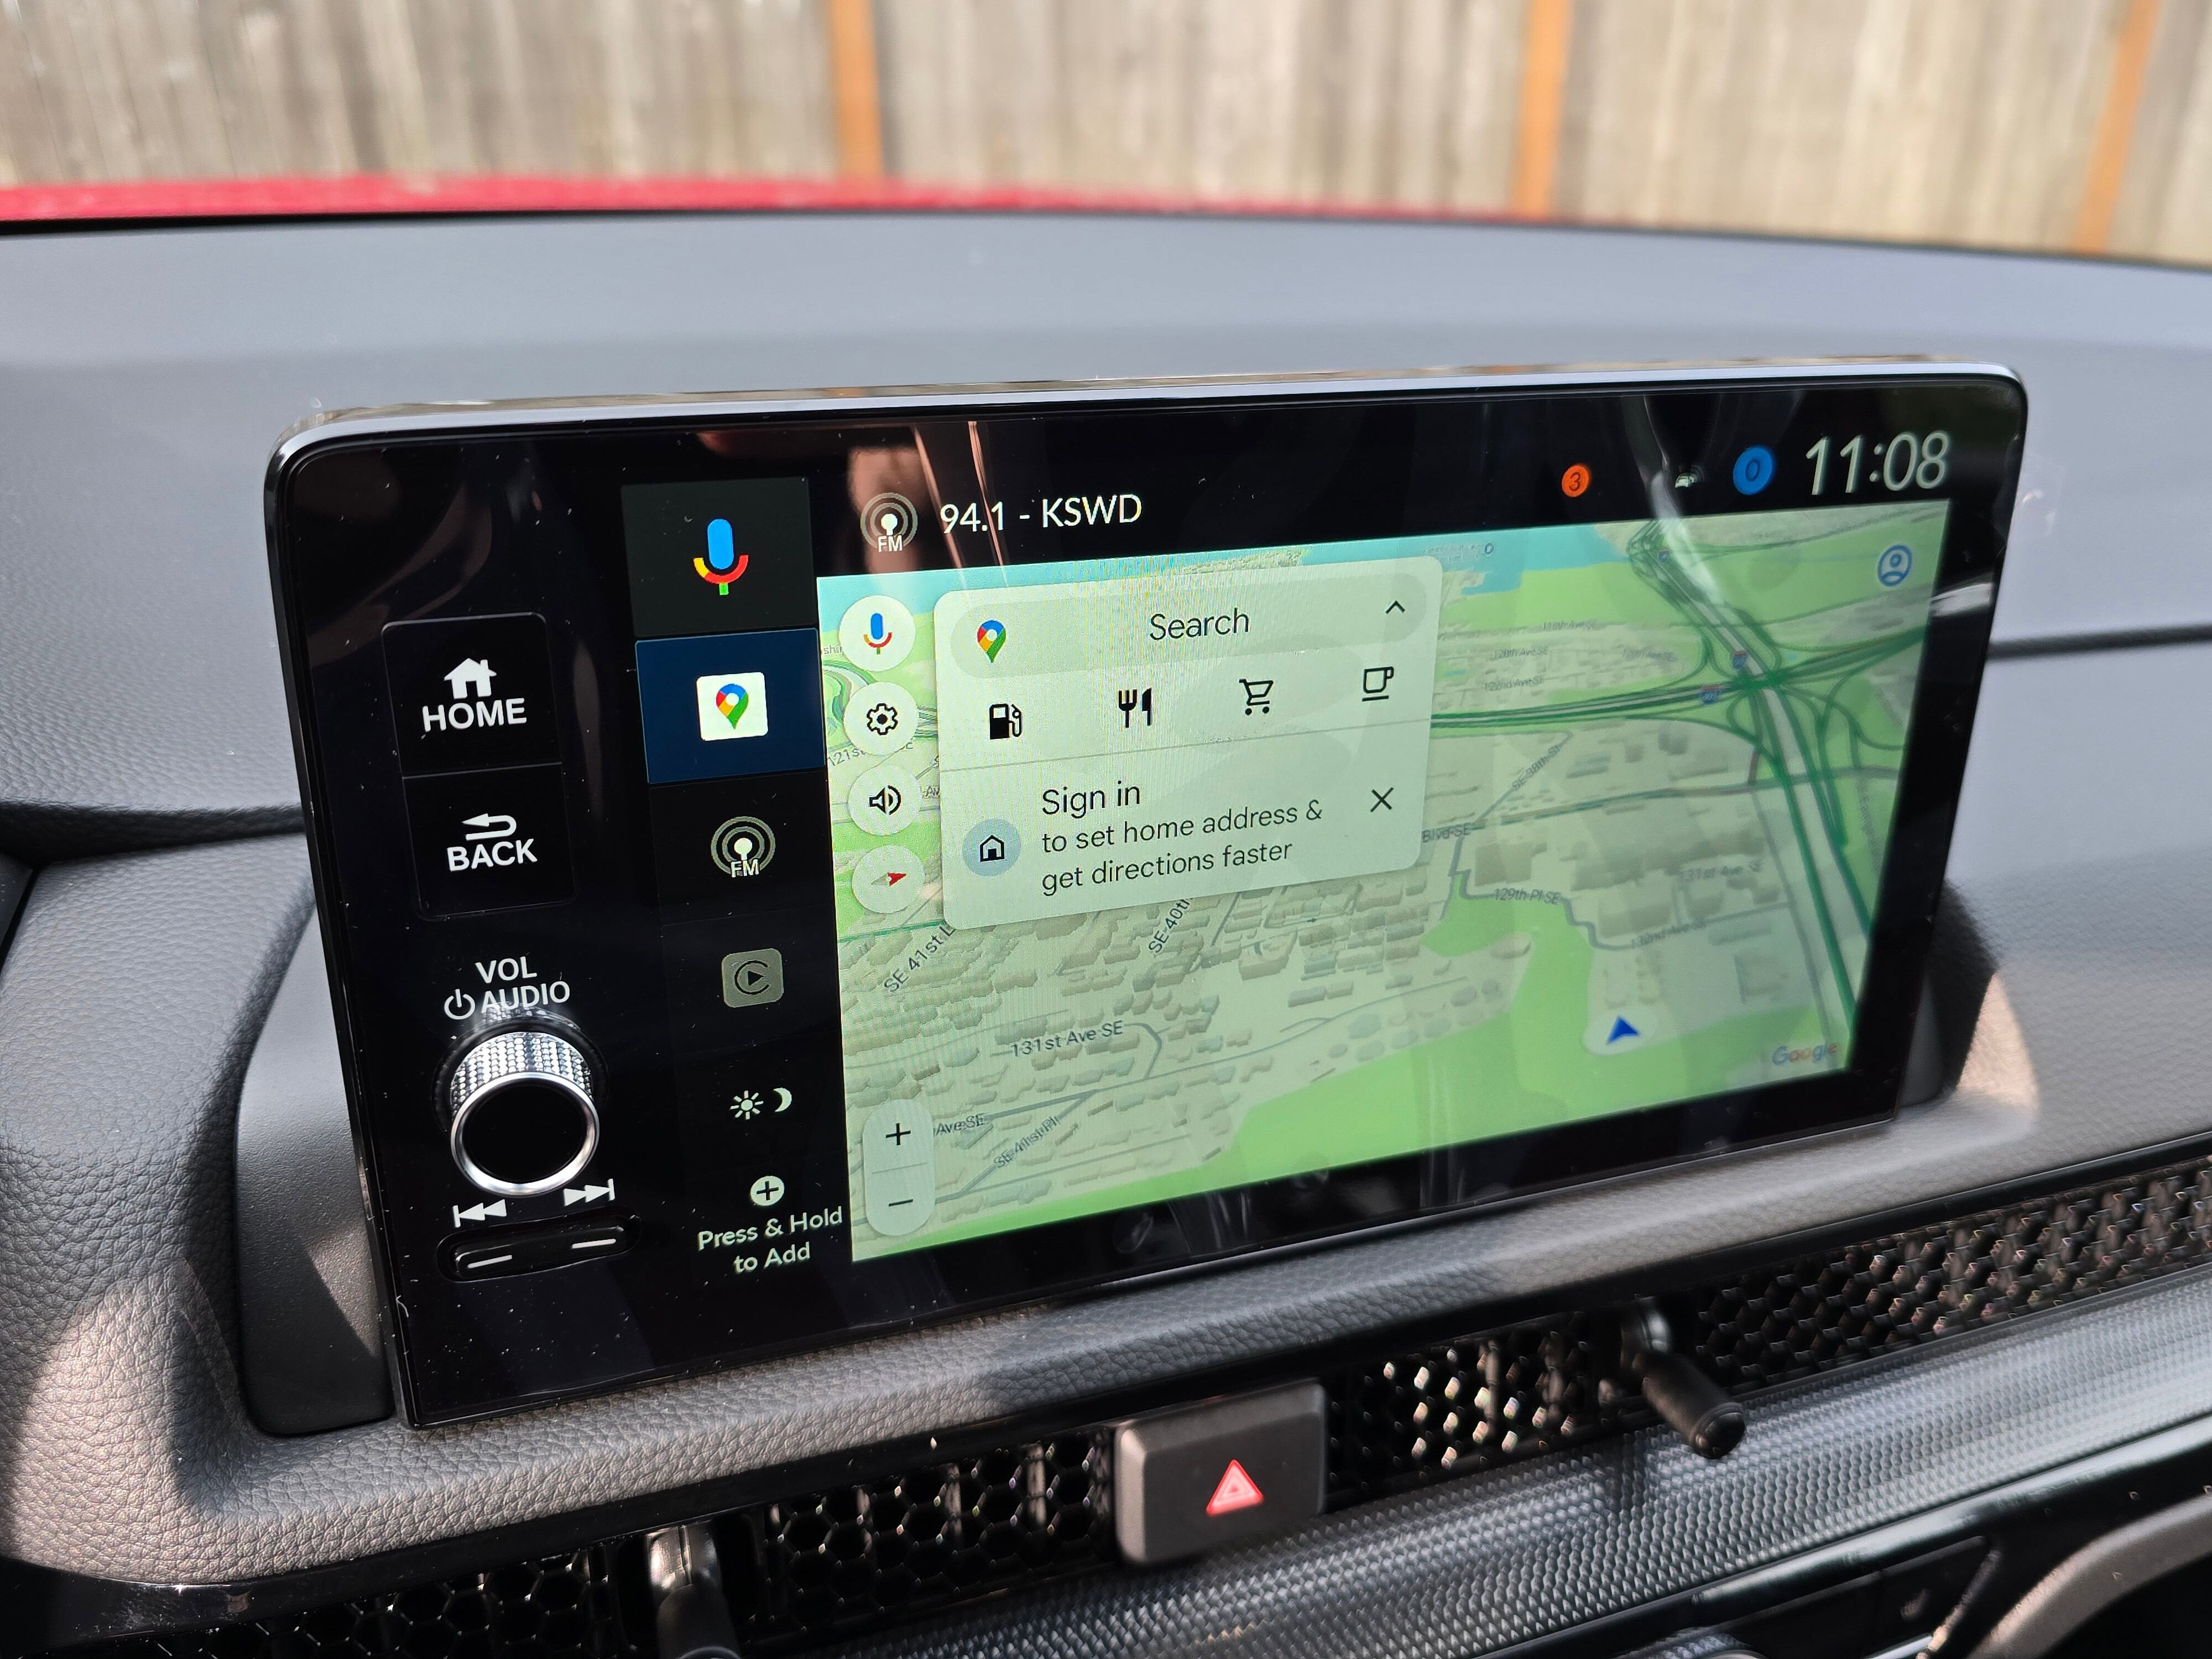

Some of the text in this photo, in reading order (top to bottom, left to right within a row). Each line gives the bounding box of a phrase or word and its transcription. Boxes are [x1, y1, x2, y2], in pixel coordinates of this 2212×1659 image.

[1806, 431, 1950, 495] 11:08
[1568, 471, 1582, 492] 3
[940, 501, 1004, 534] 94.1
[1042, 493, 1142, 528] KSWD
[878, 535, 903, 552] FM
[1149, 607, 1250, 641] Search
[421, 697, 527, 733] HOME
[1042, 780, 1141, 819] Sign in
[1042, 799, 1323, 853] to set home address &
[1422, 822, 1472, 843] Blvd SE
[446, 838, 538, 872] BACK
[731, 859, 760, 878] FM
[1042, 842, 1293, 896] get directions faster
[1494, 888, 1526, 901] 129th
[1149, 930, 1170, 953] SE
[475, 956, 538, 984] VOL
[884, 968, 910, 992] SE
[909, 935, 943, 970] 41st
[481, 980, 571, 1014] AUDIO
[1011, 1020, 1123, 1057] 131st Ave SE
[698, 1206, 843, 1251] Press & Hold
[733, 1241, 811, 1273] to Add
